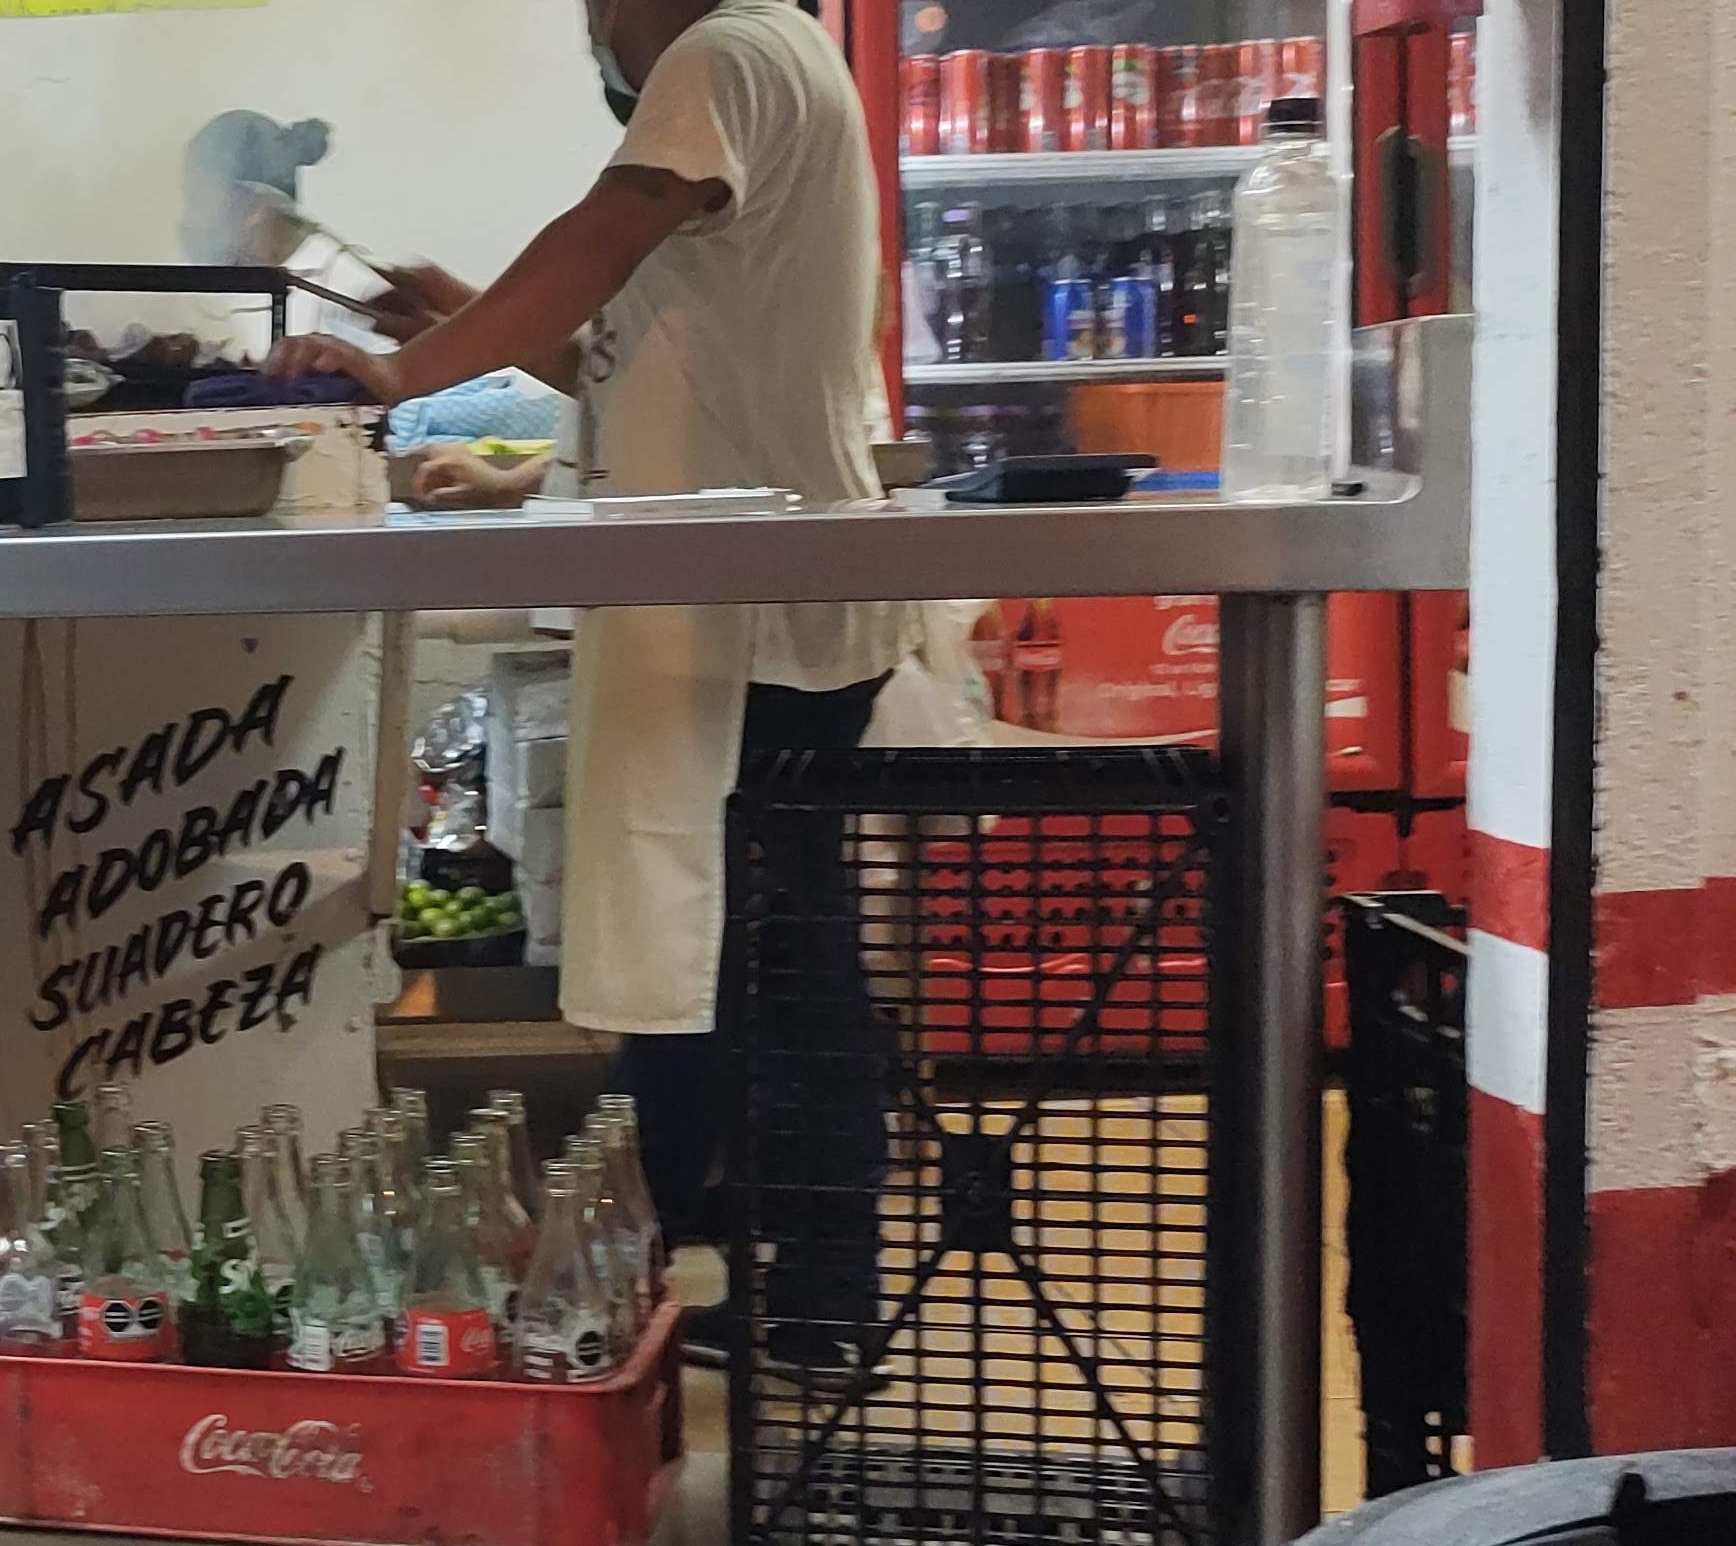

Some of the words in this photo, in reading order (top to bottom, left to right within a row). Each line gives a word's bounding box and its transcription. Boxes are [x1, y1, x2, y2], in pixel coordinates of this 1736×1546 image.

[10, 674, 294, 853] ASADA
[38, 746, 345, 940] ADOBADA
[26, 861, 310, 1031] SUADERO
[55, 944, 322, 1101] CABEZA
